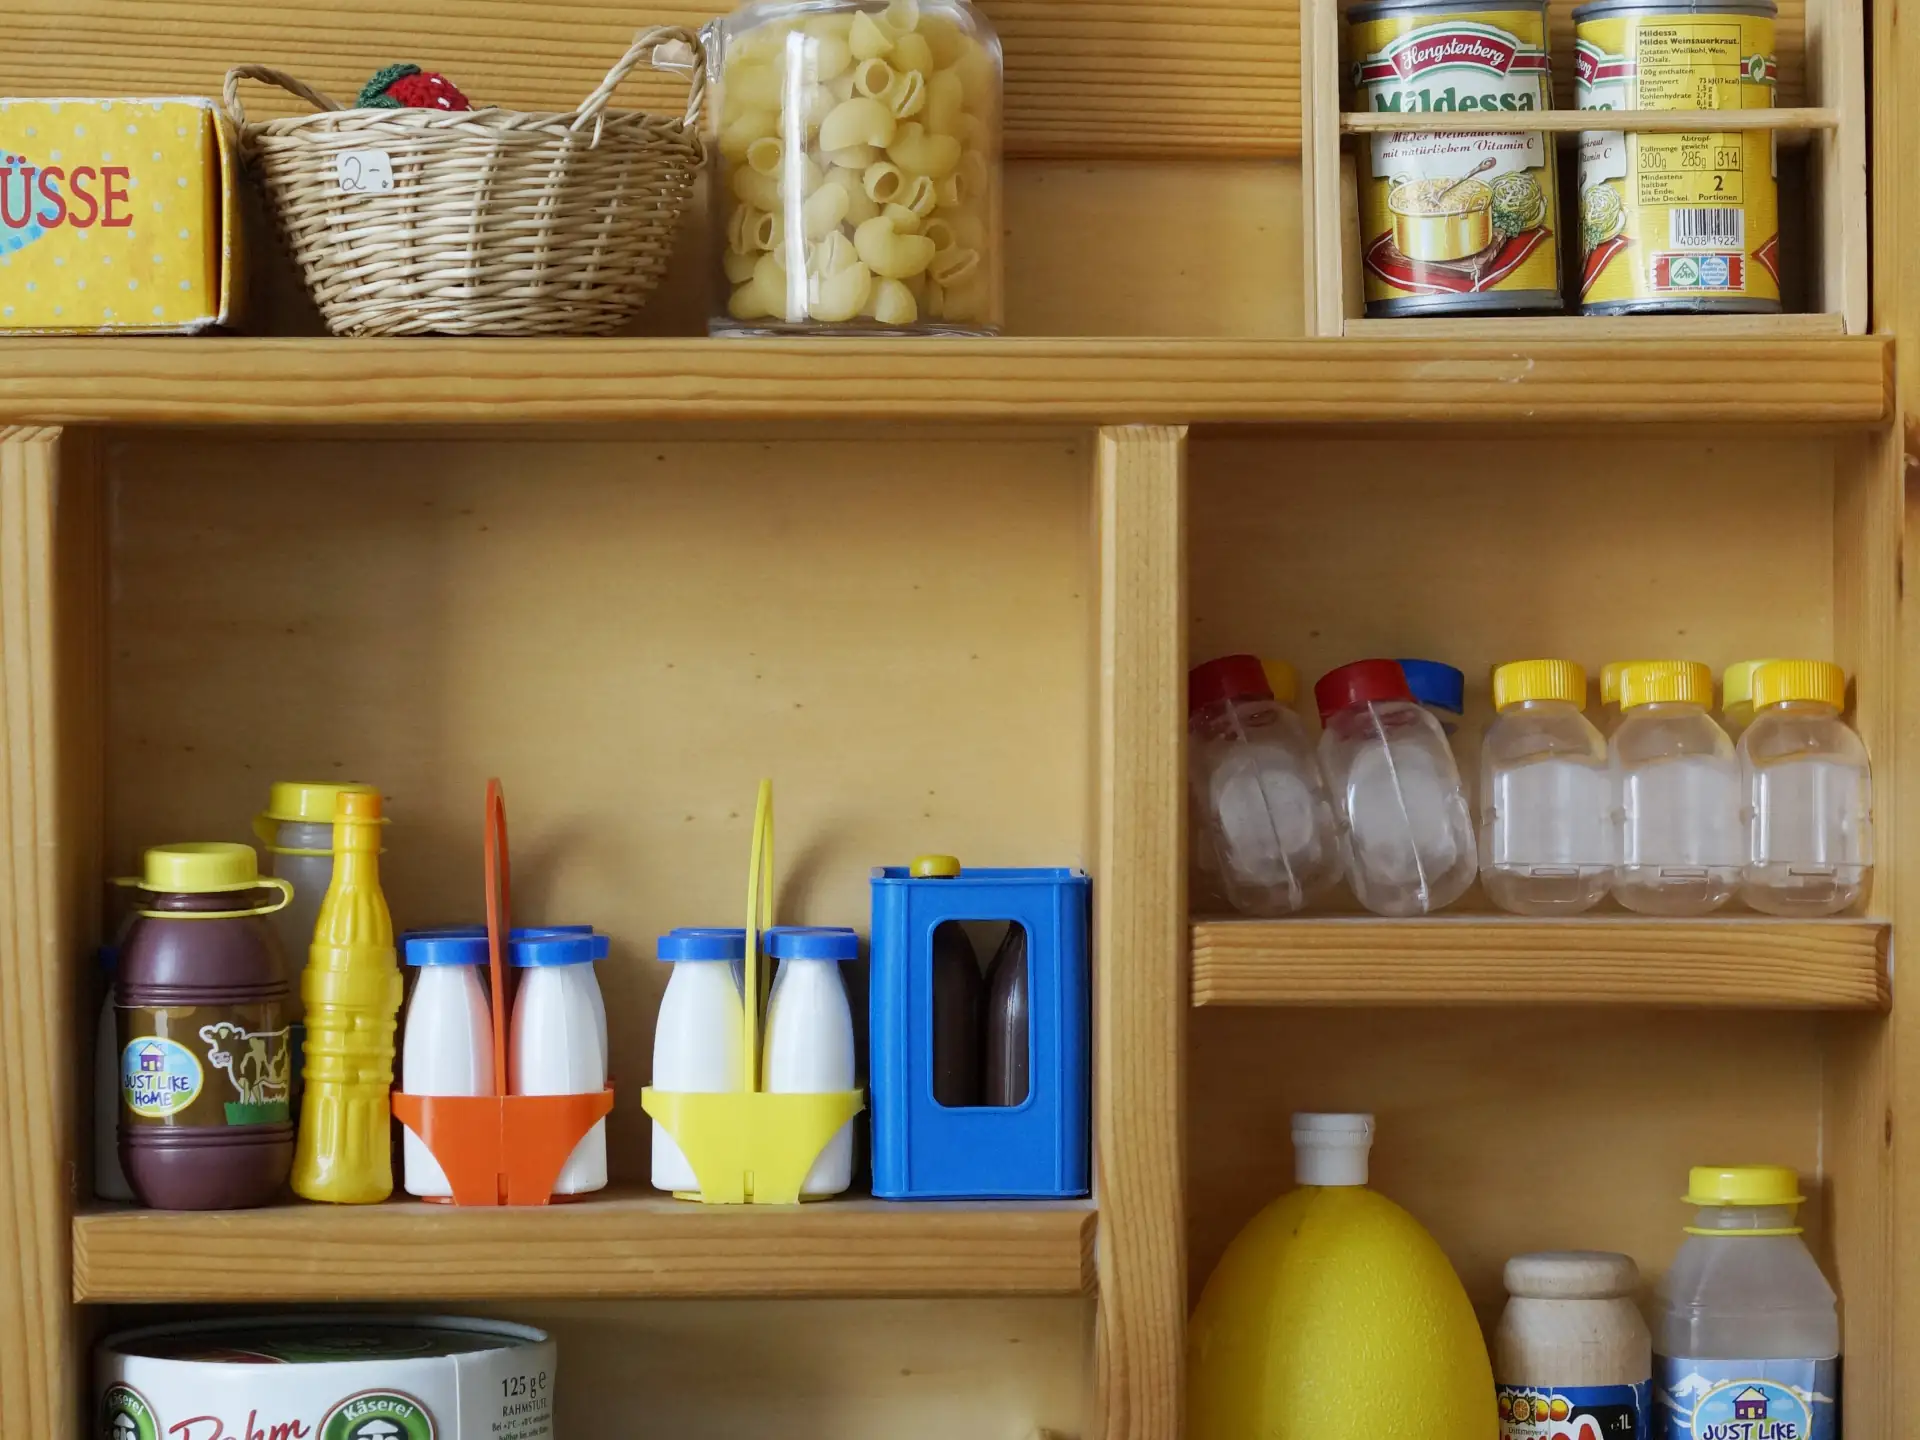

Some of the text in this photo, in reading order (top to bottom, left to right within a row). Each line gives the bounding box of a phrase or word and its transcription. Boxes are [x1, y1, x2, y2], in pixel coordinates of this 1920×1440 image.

[1639, 29, 1677, 37] Mildessa
[1401, 38, 1505, 69] Hengstenberg
[1382, 148, 1399, 160] mit
[1473, 138, 1524, 151] Vitamin
[1526, 138, 1535, 150] C
[1641, 152, 1667, 169] 300g
[1681, 151, 1707, 168] 285g
[1717, 151, 1738, 168] 314
[1713, 175, 1724, 191] 2
[1698, 193, 1738, 201] Portionen
[1680, 236, 1736, 246] 4008 1922
[124, 1075, 190, 1091] JUST LIKE
[134, 1090, 172, 1105] HOME
[502, 1376, 526, 1397] 125
[342, 1400, 413, 1421] Käserei
[1703, 1422, 1797, 1440] JUST LIKE
